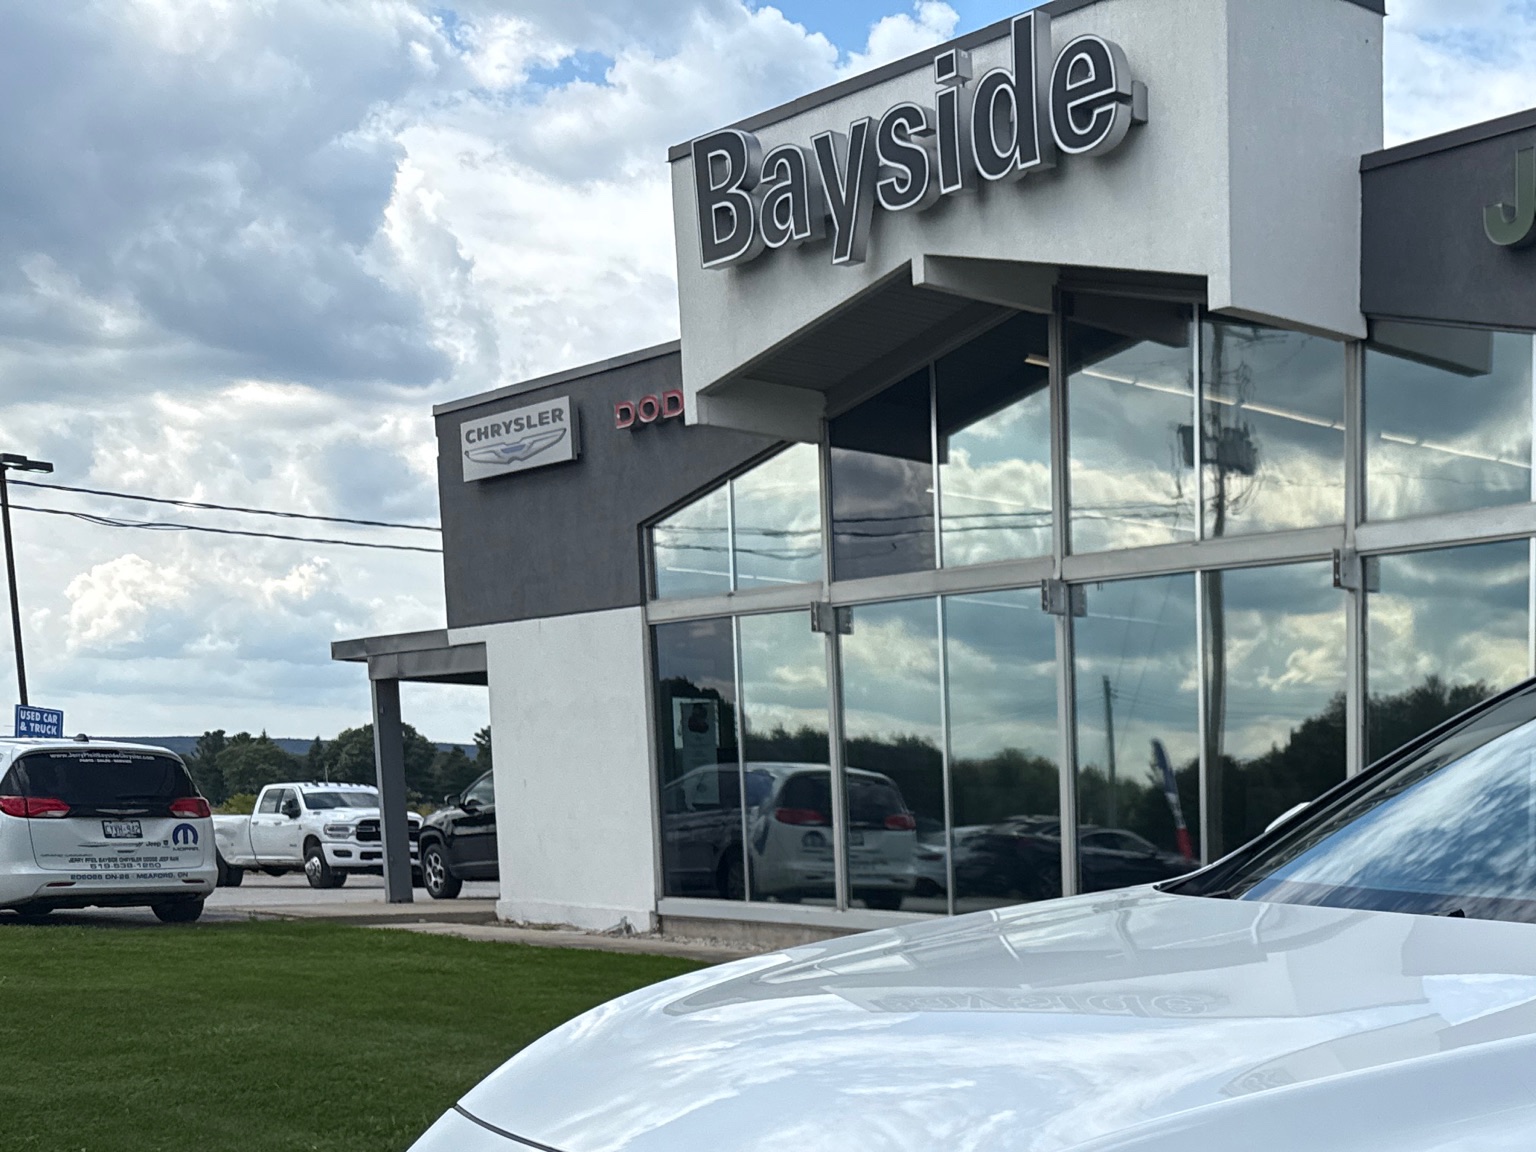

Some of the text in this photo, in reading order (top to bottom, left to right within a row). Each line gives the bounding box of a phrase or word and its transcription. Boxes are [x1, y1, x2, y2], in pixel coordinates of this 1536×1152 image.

[690, 9, 1130, 270] Bayside
[465, 408, 564, 444] CHRYSLER
[20, 710, 58, 724] USED CAR
[20, 722, 57, 735] & TRUCK
[146, 840, 162, 848] Jeep
